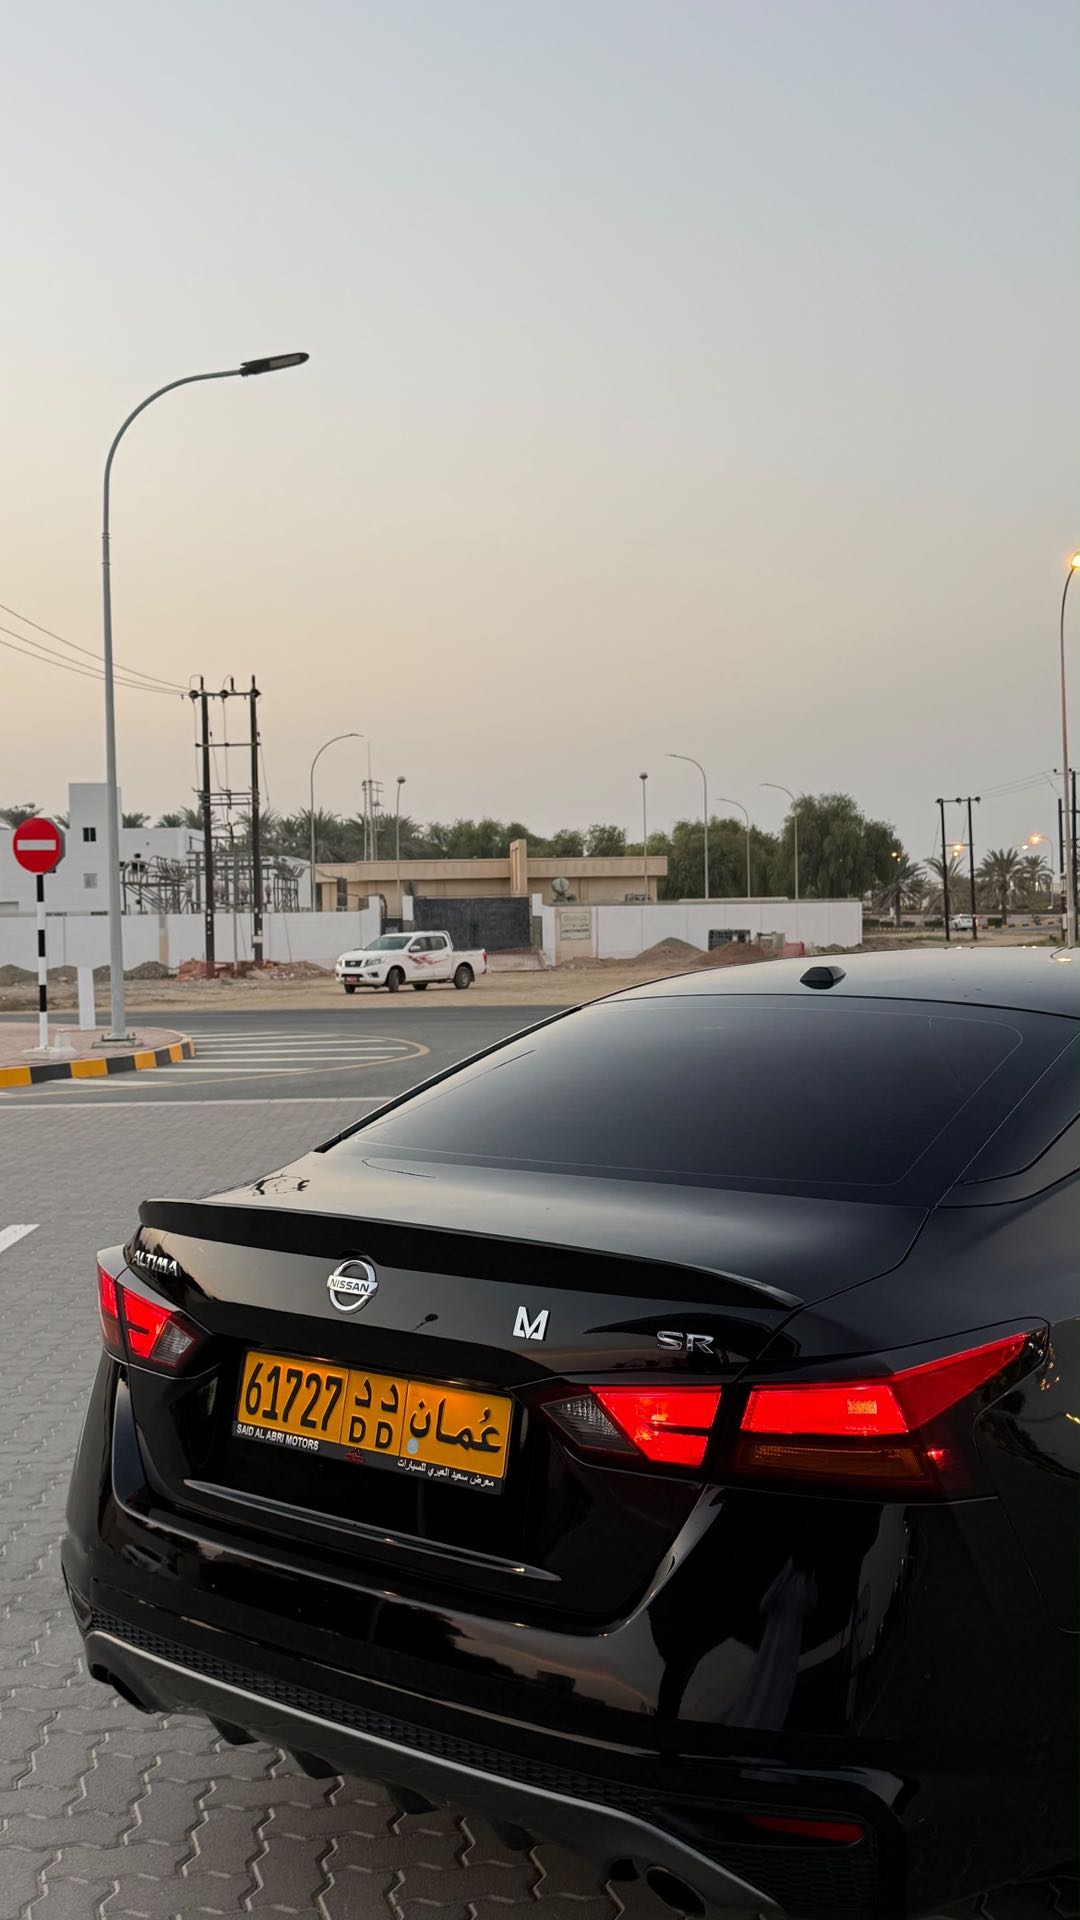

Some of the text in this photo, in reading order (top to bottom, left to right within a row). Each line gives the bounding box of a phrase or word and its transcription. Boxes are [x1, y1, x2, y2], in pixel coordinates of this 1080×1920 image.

[132, 1250, 178, 1276] ALTIMA
[330, 1278, 370, 1293] NISSAN
[656, 1330, 714, 1354] SR
[245, 1362, 343, 1431] 61727
[236, 1423, 319, 1451] SAID AL ABRI MOTORS
[397, 1458, 427, 1473] للسيارات
[451, 1469, 469, 1482] سعيد
[469, 1474, 495, 1488] معرض
